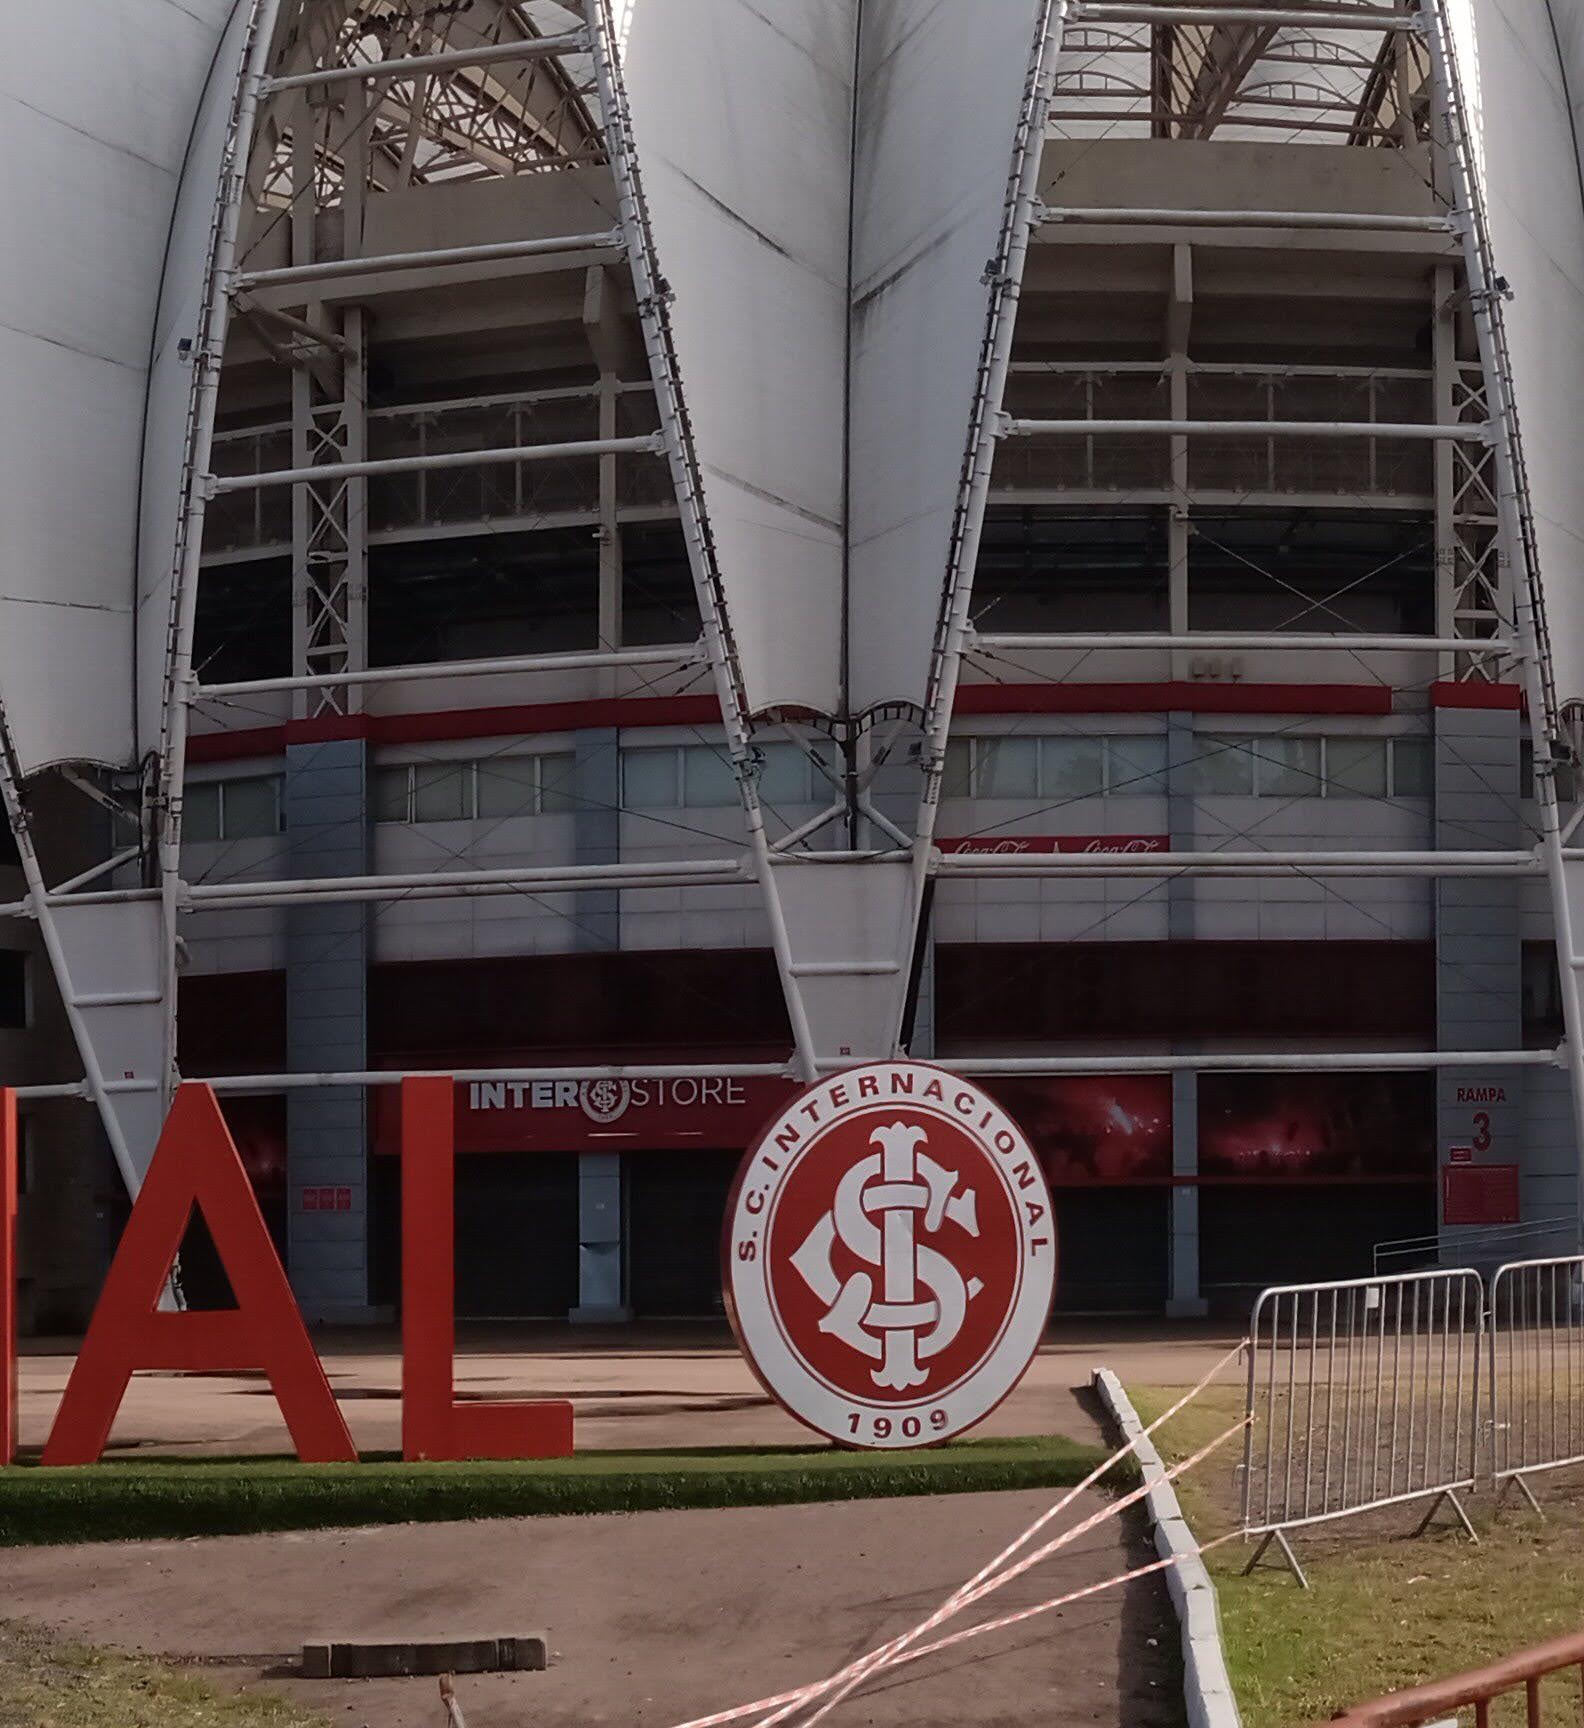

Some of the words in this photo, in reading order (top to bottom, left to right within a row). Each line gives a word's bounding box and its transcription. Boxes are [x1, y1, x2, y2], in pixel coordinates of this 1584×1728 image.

[469, 1081, 580, 1110] INTER
[630, 1077, 746, 1106] STORE
[1457, 1087, 1506, 1103] RAMPA
[1472, 1111, 1492, 1151] 3
[762, 1072, 1048, 1257] INTERNACIONAL
[848, 1408, 949, 1439] 1909
